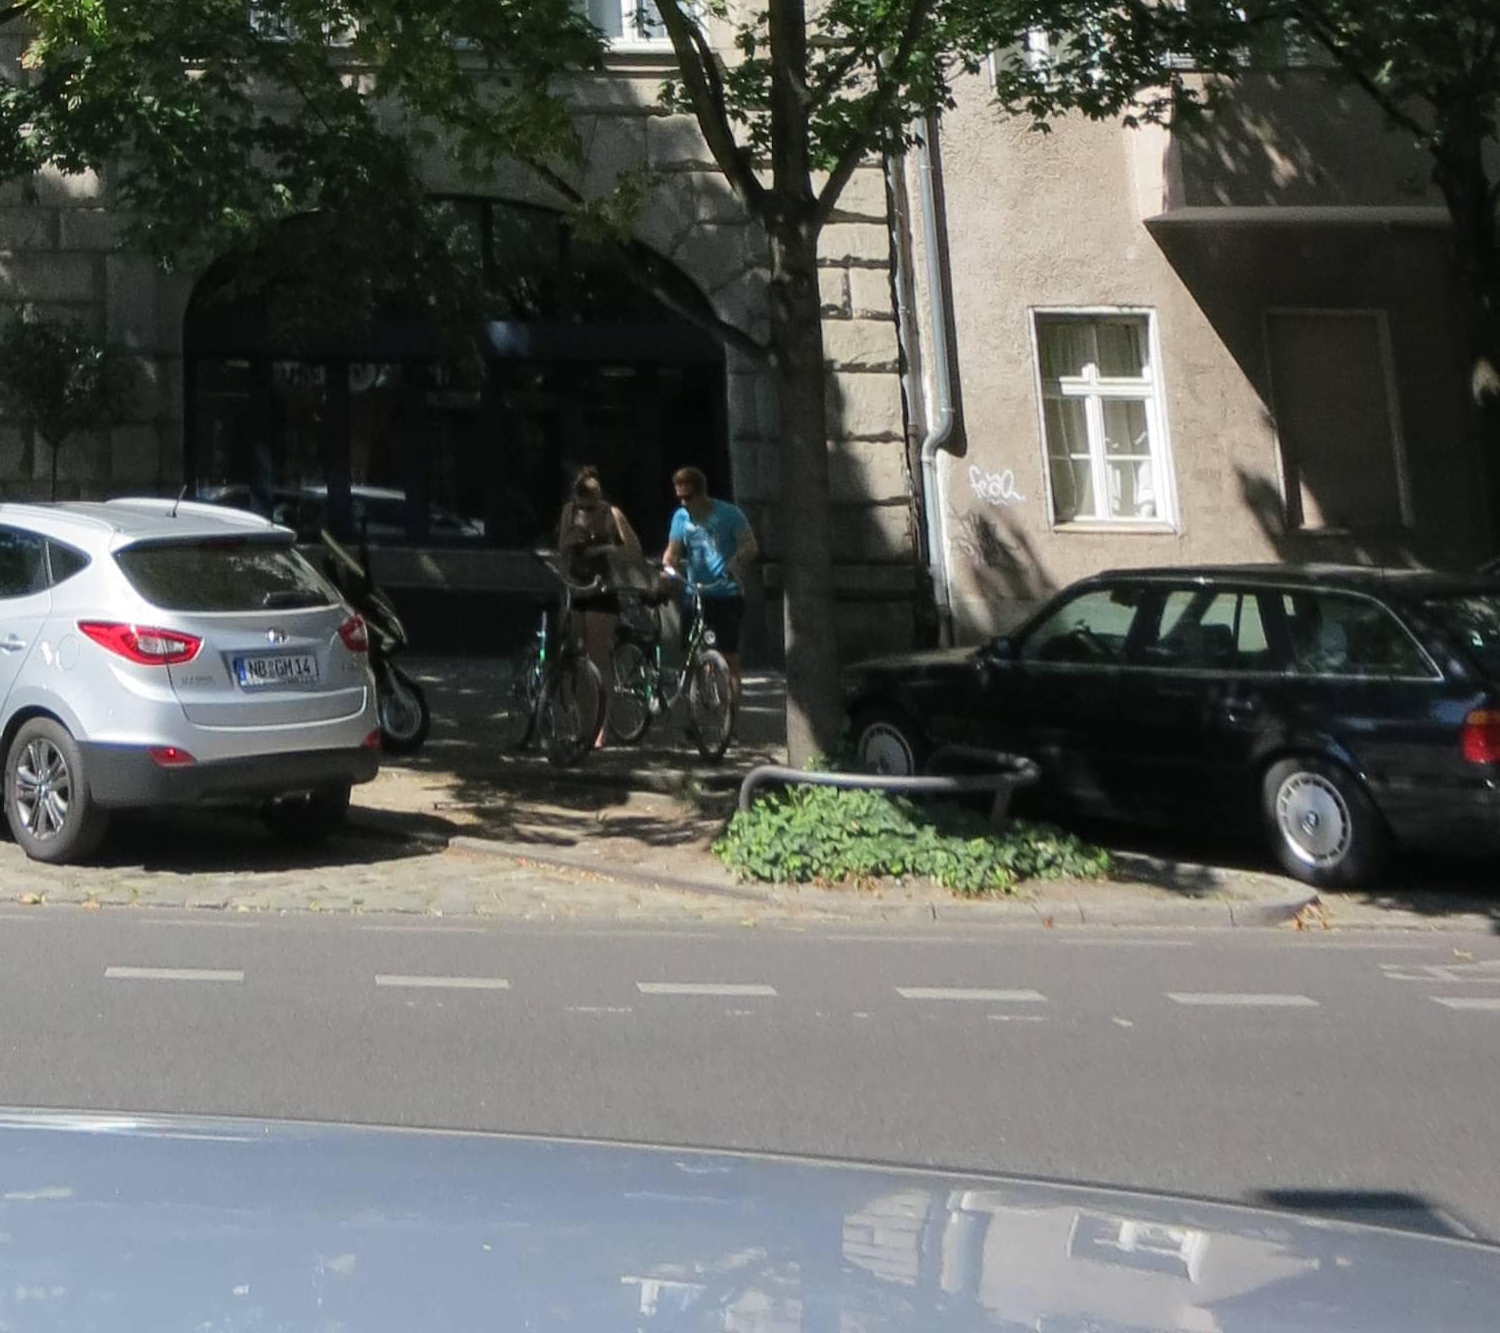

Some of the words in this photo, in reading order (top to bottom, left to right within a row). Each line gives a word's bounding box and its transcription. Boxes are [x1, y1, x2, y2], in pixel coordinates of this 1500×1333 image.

[248, 659, 267, 677] NB
[274, 658, 294, 677] GM
[295, 657, 311, 675] 14
